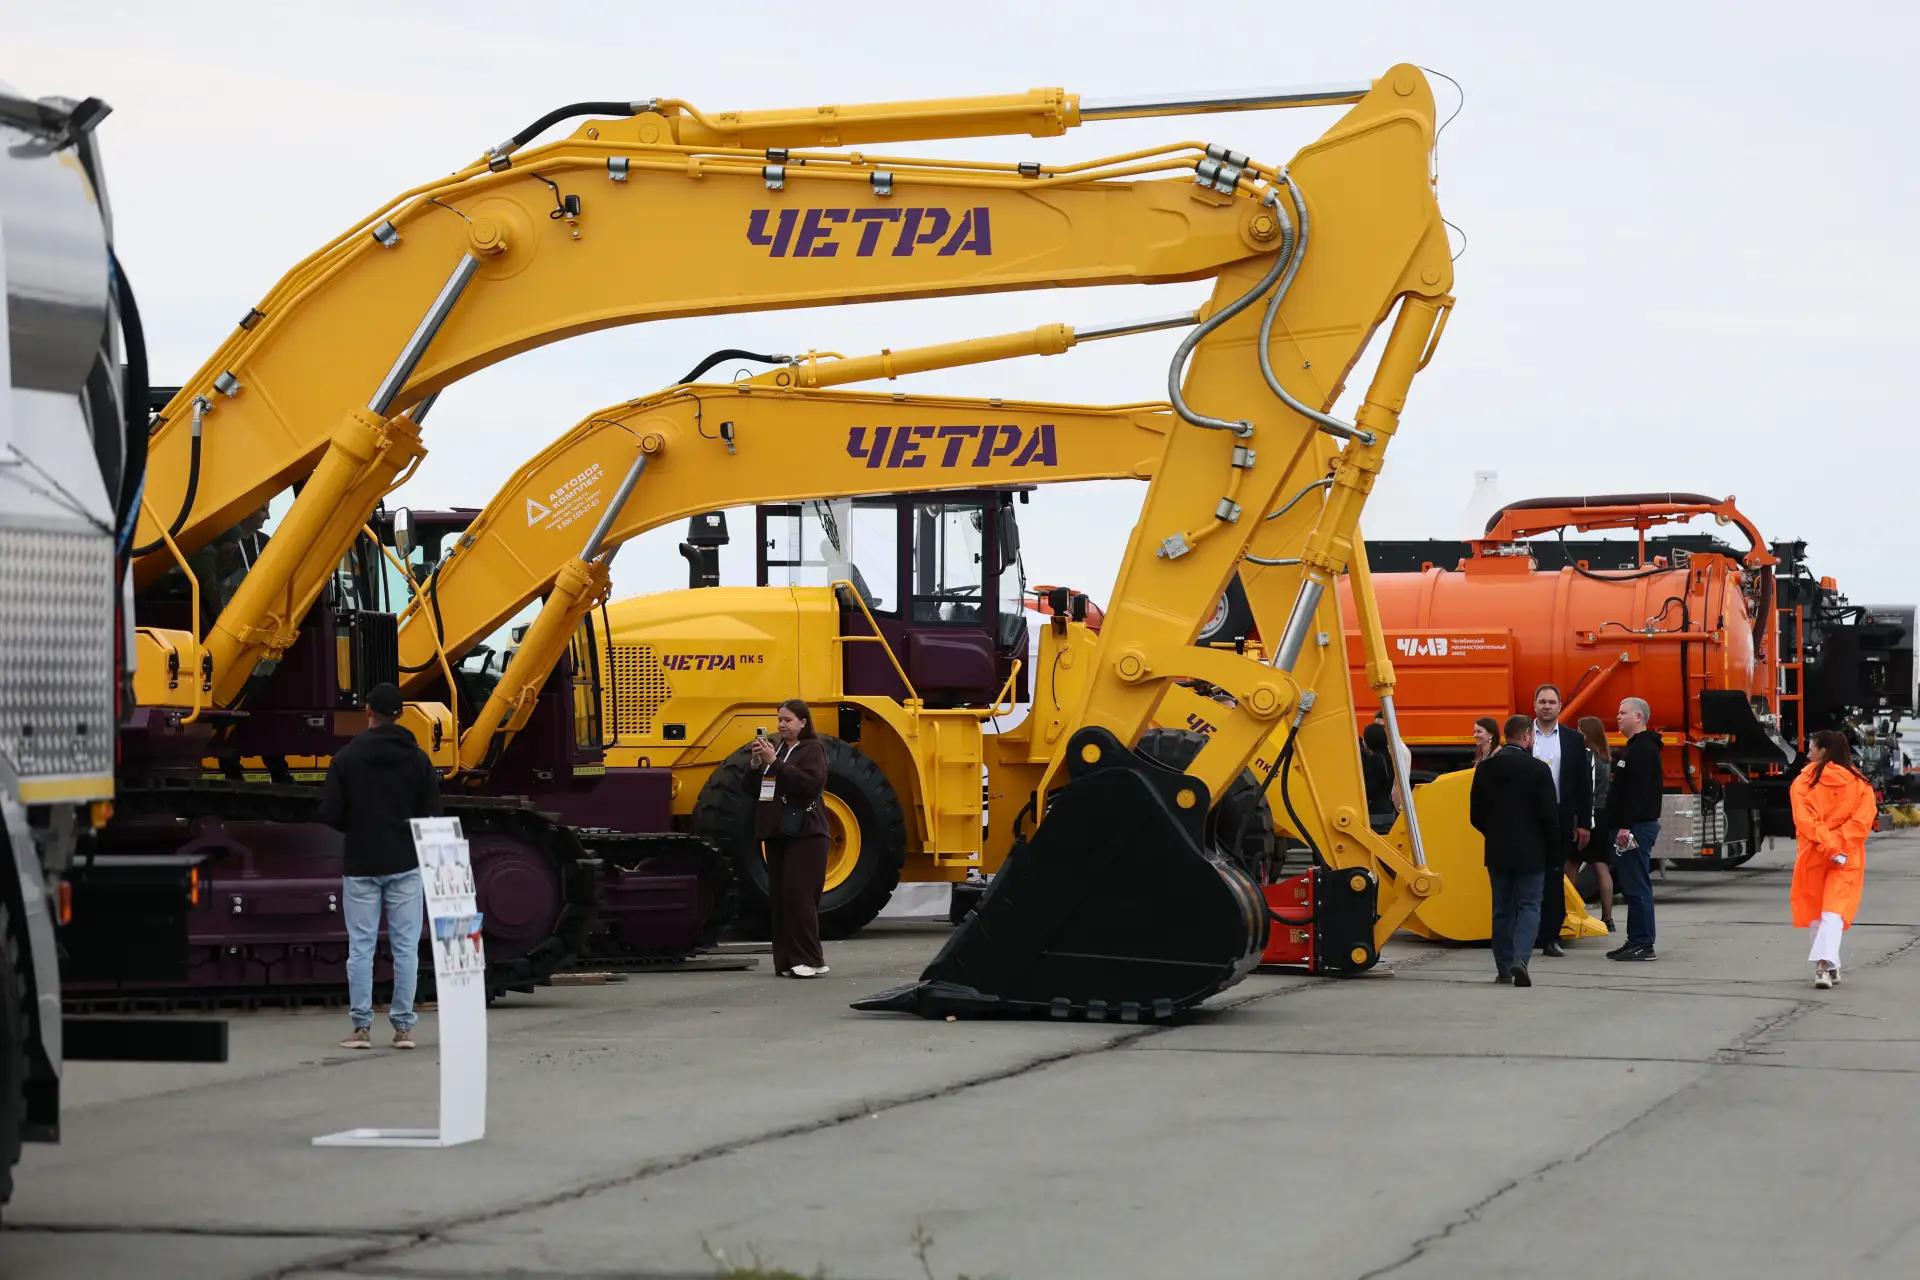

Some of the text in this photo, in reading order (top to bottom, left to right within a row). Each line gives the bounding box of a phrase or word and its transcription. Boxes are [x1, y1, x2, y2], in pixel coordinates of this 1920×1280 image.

[746, 207, 993, 258] ЧЕТРА
[846, 424, 1058, 469] ЧЕТРА
[549, 463, 600, 503] АВТОДОР
[552, 470, 604, 509] КОМПЛЕКТ
[662, 654, 764, 671] ЧЕТРА ПК 5
[1186, 713, 1218, 734] ЧЕ
[1255, 758, 1273, 774] ПК
